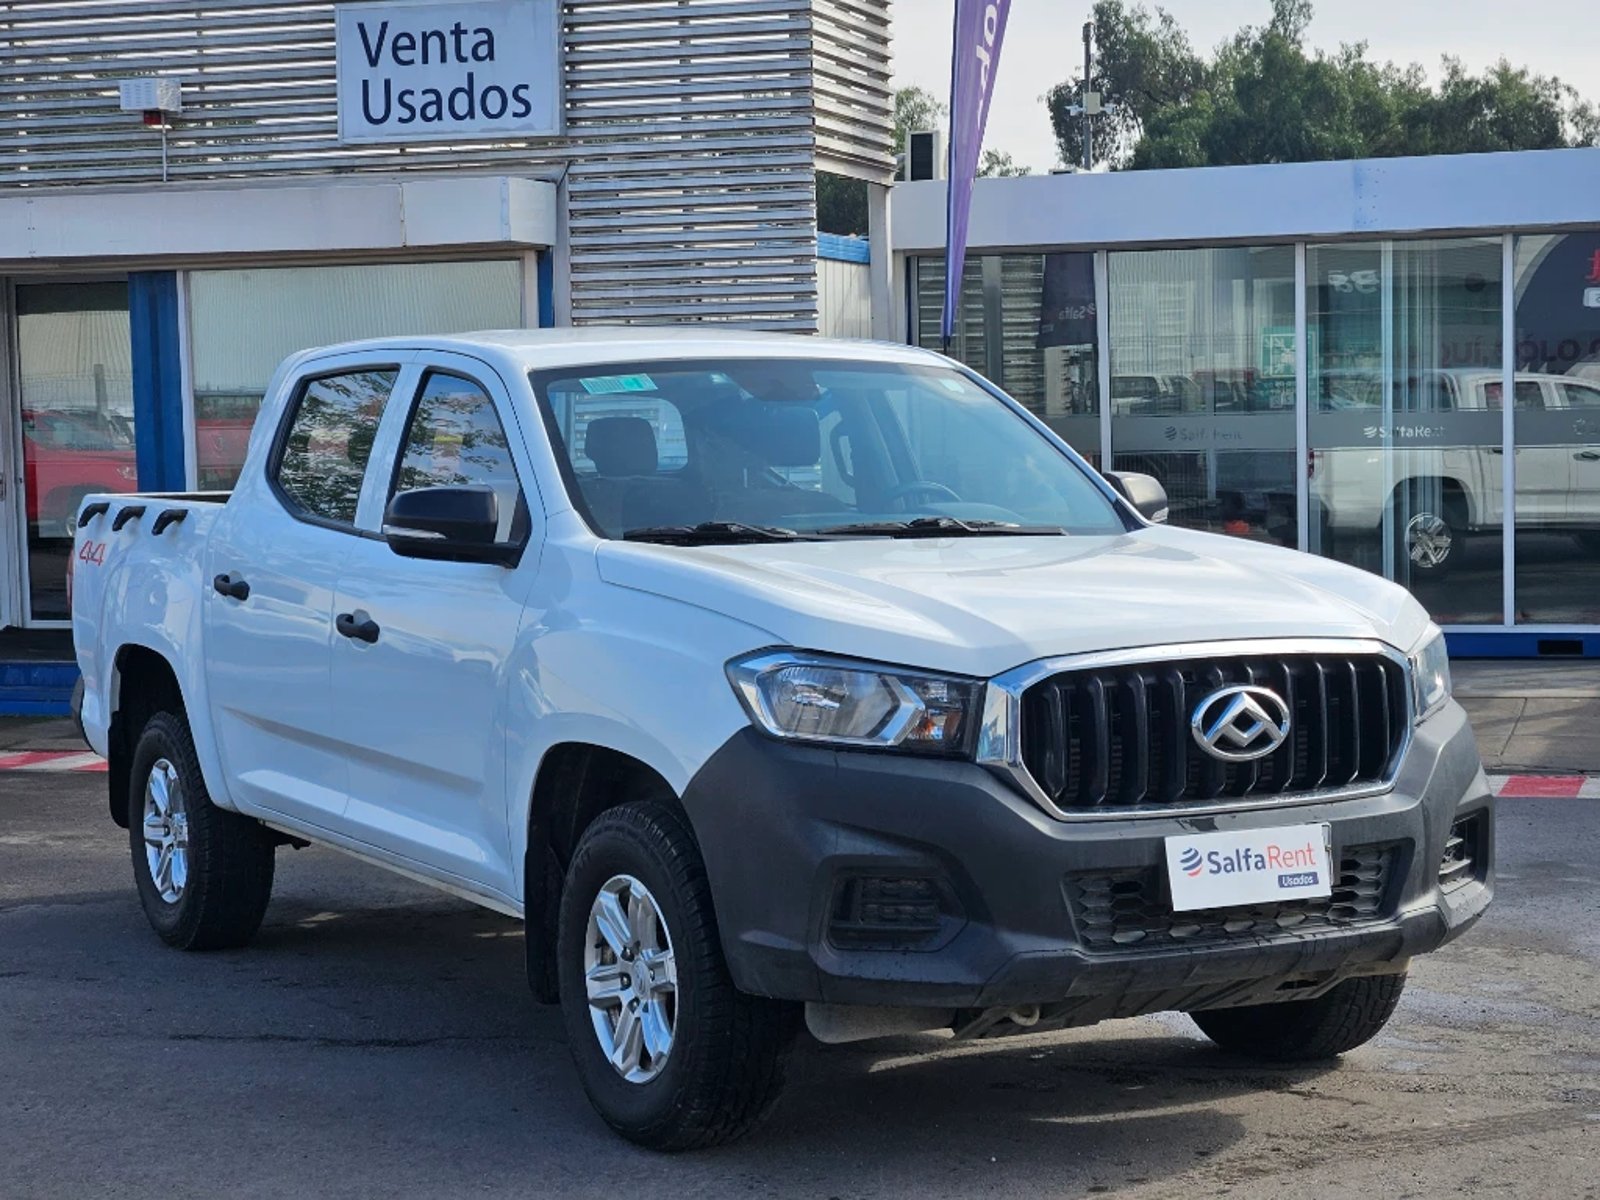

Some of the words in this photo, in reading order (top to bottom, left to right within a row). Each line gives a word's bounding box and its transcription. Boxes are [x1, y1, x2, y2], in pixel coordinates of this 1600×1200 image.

[357, 21, 496, 68] Venta
[362, 72, 532, 126] Usados
[1207, 842, 1317, 875] SalfaRent
[1282, 874, 1314, 887] Usados
